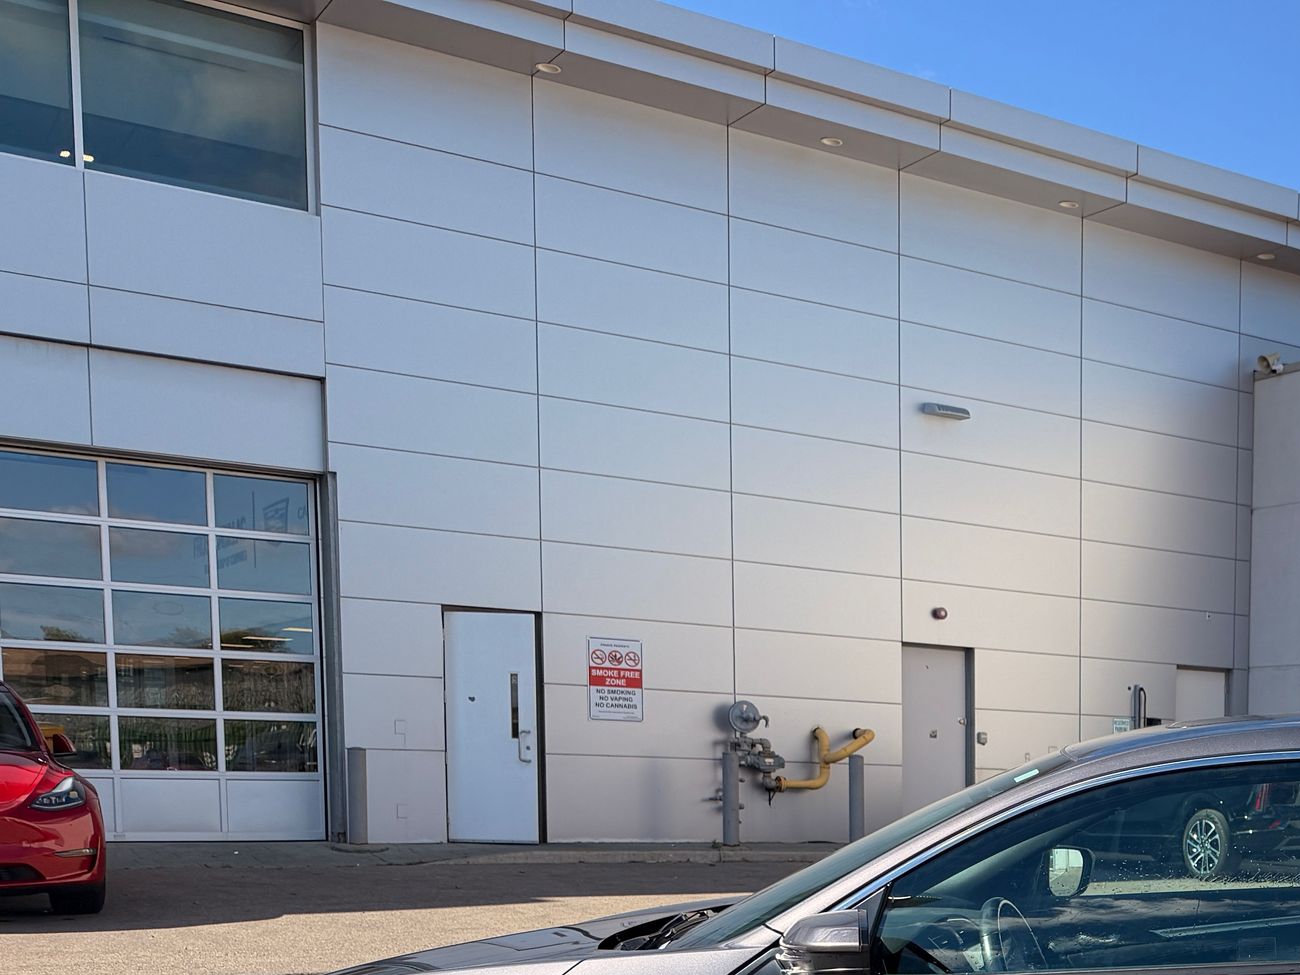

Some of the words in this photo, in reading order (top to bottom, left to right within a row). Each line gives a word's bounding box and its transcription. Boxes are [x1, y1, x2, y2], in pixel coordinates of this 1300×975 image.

[591, 668, 619, 677] SMOKE
[620, 670, 641, 679] FREE
[605, 678, 627, 686] ZONE
